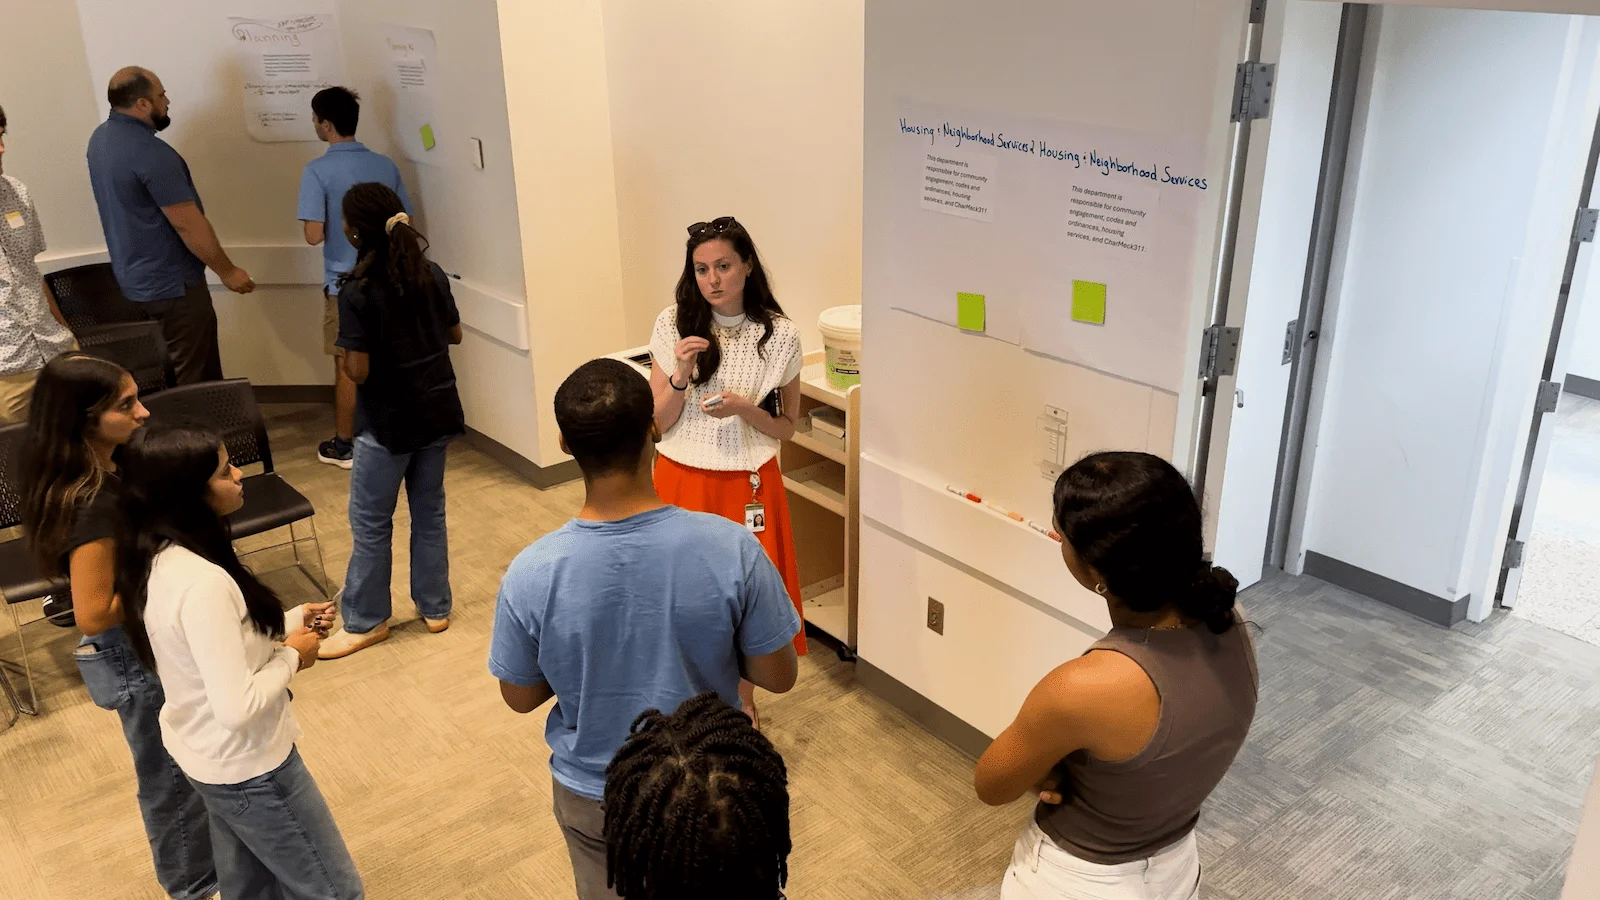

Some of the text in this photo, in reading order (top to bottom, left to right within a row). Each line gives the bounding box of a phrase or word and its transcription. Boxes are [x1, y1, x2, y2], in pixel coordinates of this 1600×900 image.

[899, 118, 934, 145] Housing
[943, 122, 995, 147] Neighborhood
[997, 133, 1029, 153] Services
[936, 157, 964, 167] department
[1039, 141, 1080, 168] Housing
[1090, 149, 1157, 181] Neighborhood
[1161, 166, 1208, 190] Services
[925, 176, 954, 186] engagement,
[926, 165, 952, 175] responsible
[960, 172, 988, 183] community
[924, 186, 971, 201] ordinances, housing
[1071, 185, 1083, 193] This
[1083, 188, 1117, 200] department
[924, 196, 943, 205] services,
[954, 201, 987, 214] CharMeck311
[1070, 198, 1103, 209] responsible
[1112, 205, 1147, 218] community
[1069, 209, 1105, 221] engagement,
[1106, 216, 1124, 225] codes
[1067, 220, 1125, 238] ordinances, housing
[1067, 231, 1091, 241] services,
[1103, 237, 1145, 252] CharMeck311
